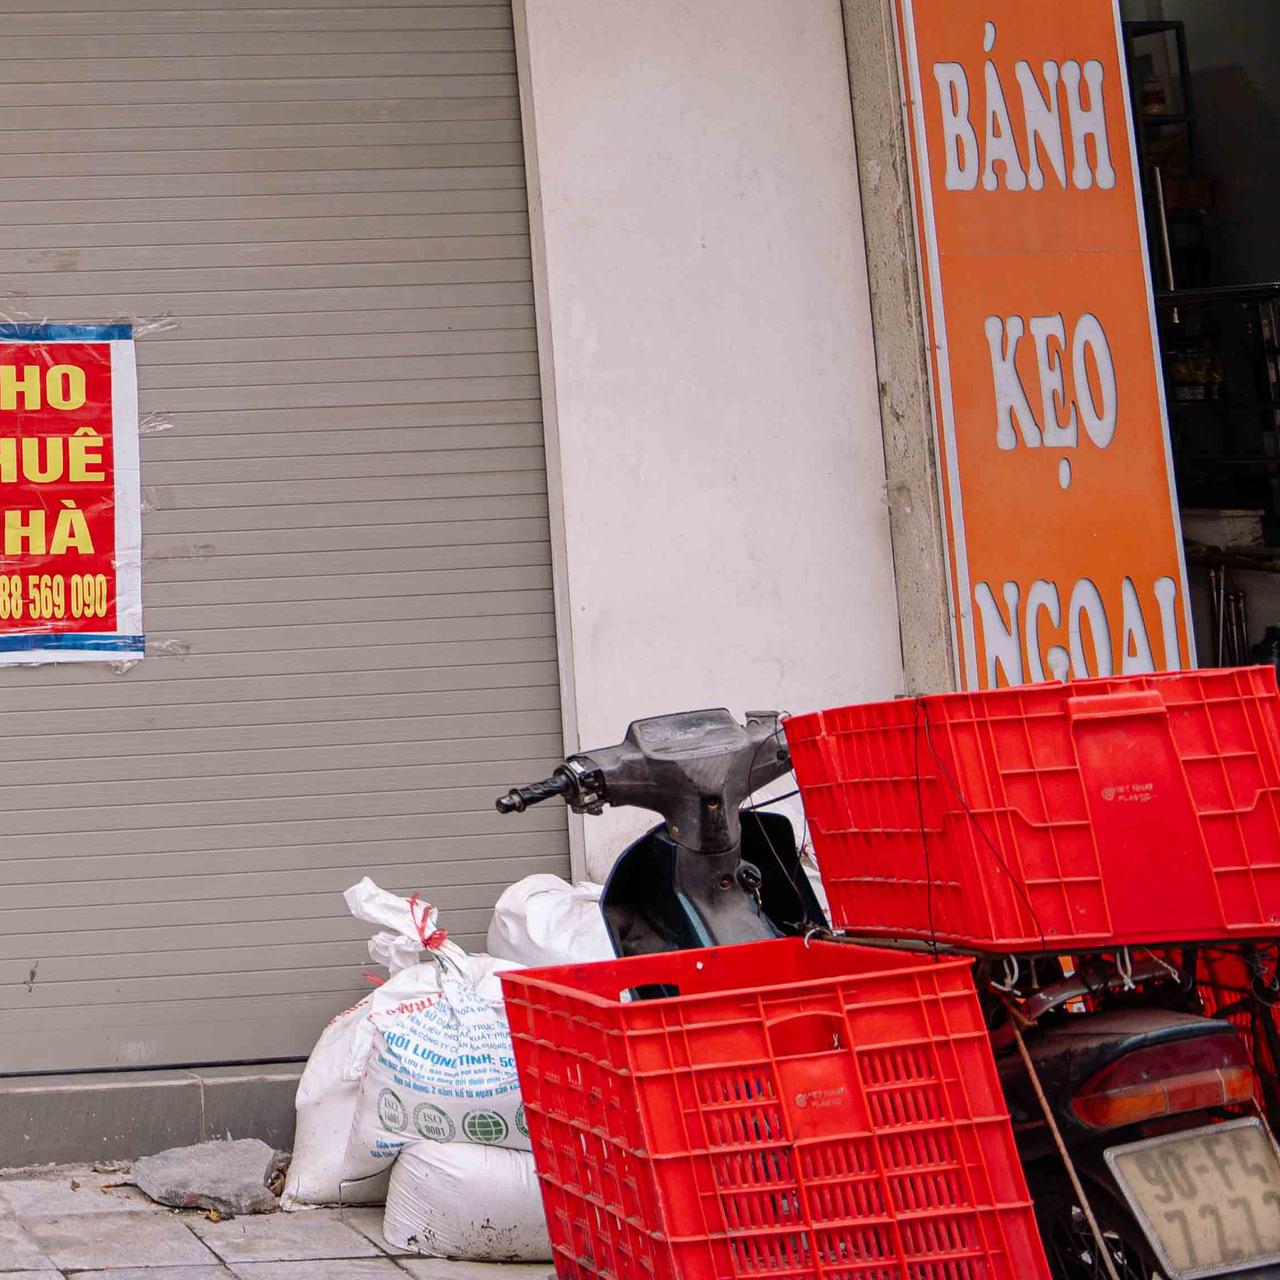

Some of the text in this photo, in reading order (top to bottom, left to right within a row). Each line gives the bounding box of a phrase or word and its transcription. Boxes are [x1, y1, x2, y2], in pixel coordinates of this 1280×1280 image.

[933, 20, 1117, 193] BÁNH
[983, 311, 1118, 490] KẸO
[29, 573, 65, 619] 569
[71, 573, 107, 618] 090
[422, 1111, 442, 1125] ISO
